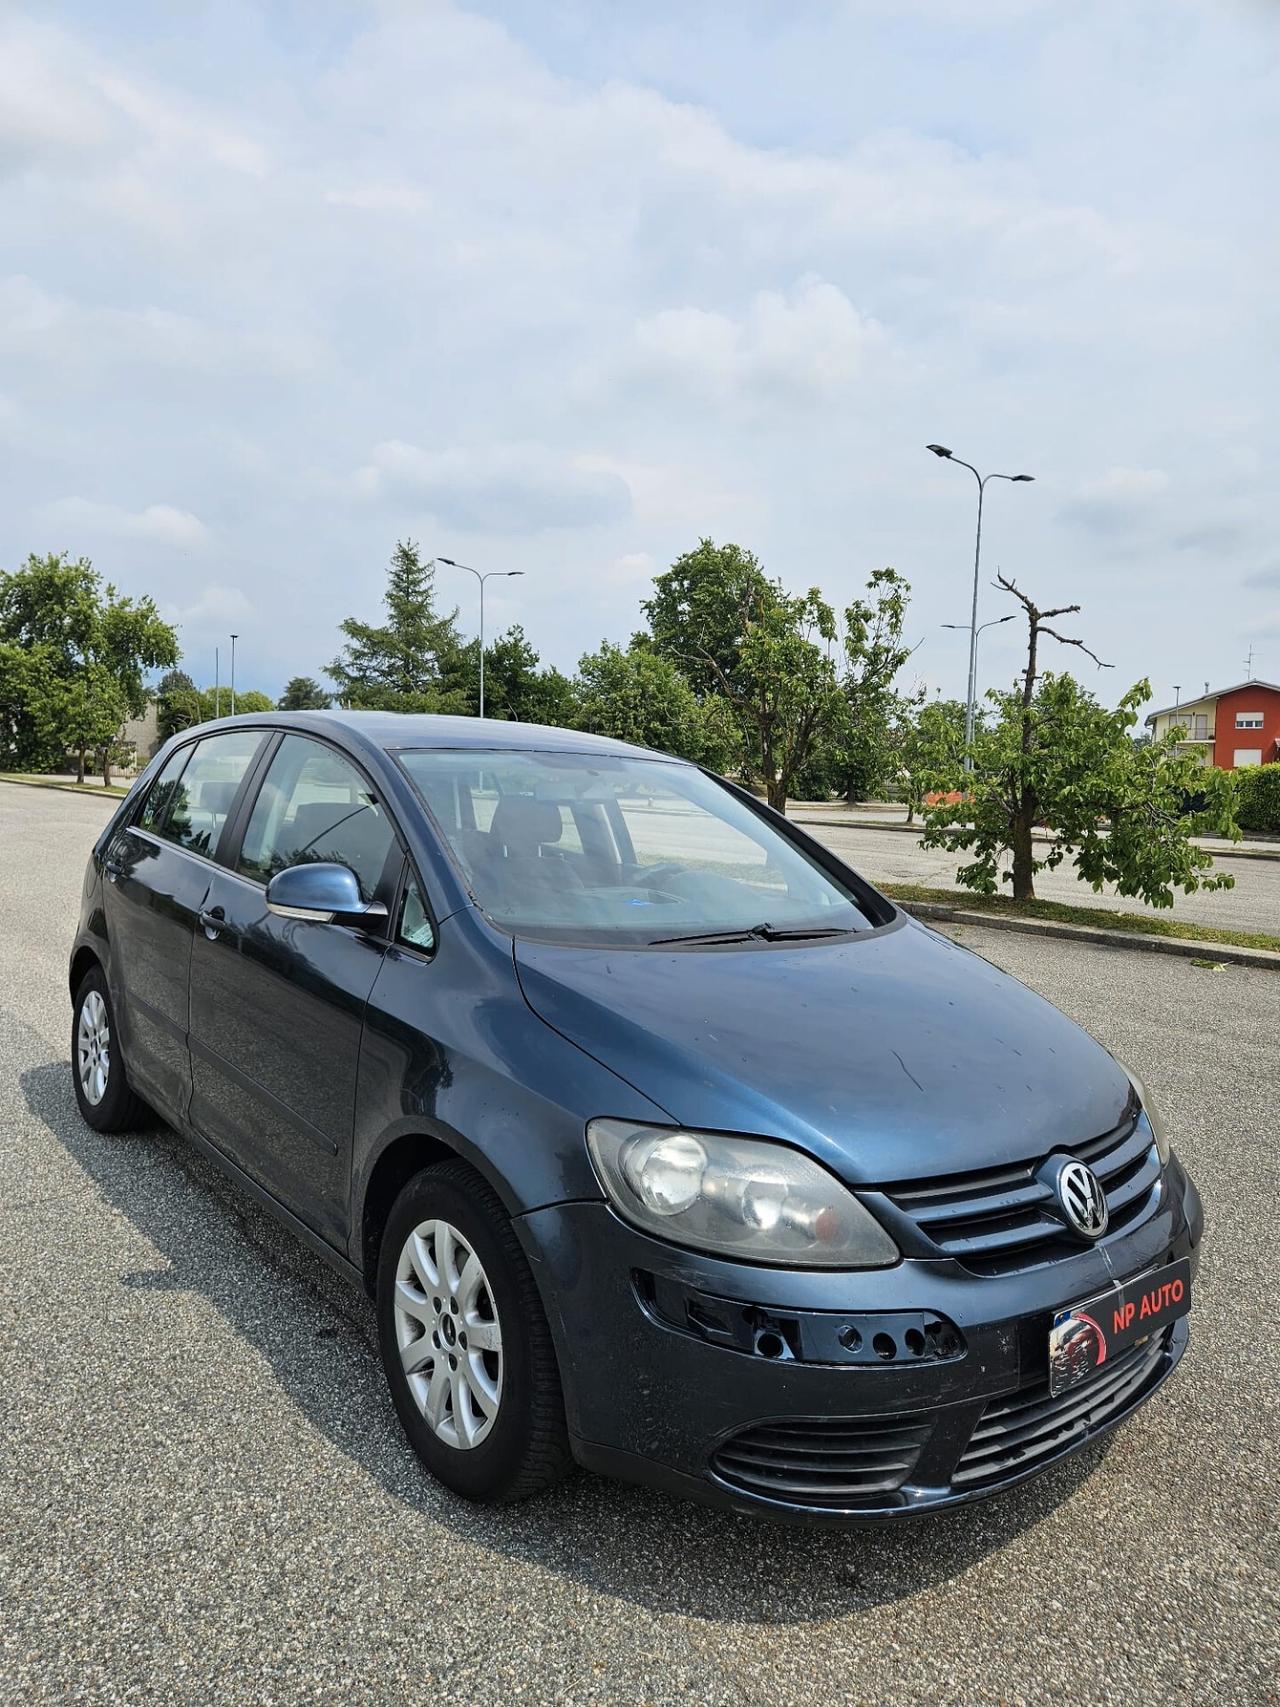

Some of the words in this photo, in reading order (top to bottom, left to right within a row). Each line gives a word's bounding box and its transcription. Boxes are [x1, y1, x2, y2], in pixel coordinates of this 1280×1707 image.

[1061, 1163, 1108, 1235] VW
[1113, 1302, 1135, 1334] NP
[1140, 1279, 1184, 1320] AUTO
